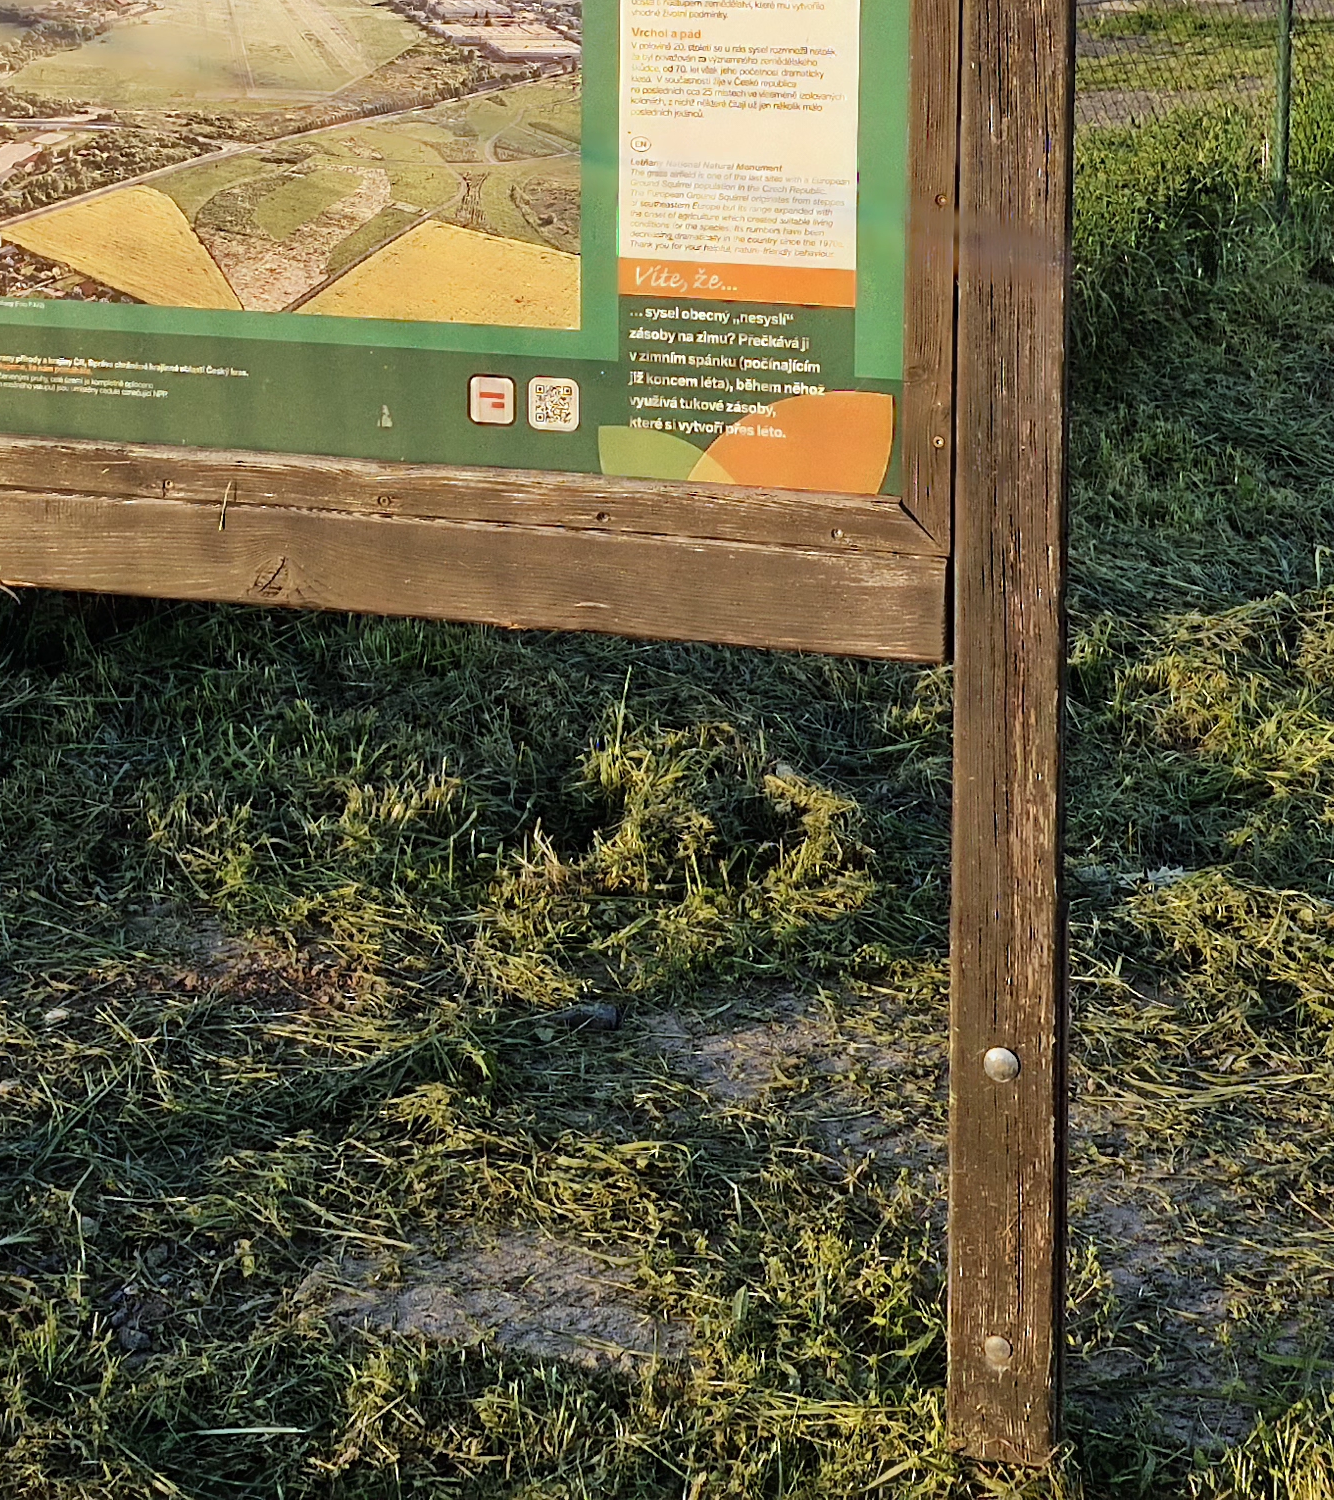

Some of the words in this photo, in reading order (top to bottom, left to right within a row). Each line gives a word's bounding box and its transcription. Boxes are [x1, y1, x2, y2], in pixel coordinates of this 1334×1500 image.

[632, 27, 668, 38] Vrchol
[671, 30, 677, 38] a
[635, 265, 687, 292] Víte,
[645, 308, 679, 320] sysel
[682, 310, 730, 324] obecný
[629, 328, 675, 343] zásoby
[678, 334, 693, 342] na
[697, 332, 735, 345] zimu?
[739, 334, 799, 349] Přečkává
[799, 338, 809, 352] ji
[629, 353, 637, 361] v
[639, 352, 685, 364] zimním
[689, 354, 736, 369] spánku
[739, 356, 820, 373] (počínajícím
[628, 372, 643, 386] již
[646, 374, 697, 386] koncem
[701, 376, 733, 391] léta),
[736, 378, 781, 394] během
[785, 382, 825, 396] něhož
[629, 396, 677, 409] využívá
[680, 399, 723, 412] tukové
[726, 401, 776, 417] zásoby,
[629, 418, 662, 428] které
[665, 421, 675, 430] si
[679, 420, 725, 436] vytvoří
[726, 425, 754, 438] přes
[757, 425, 786, 438] léto.
